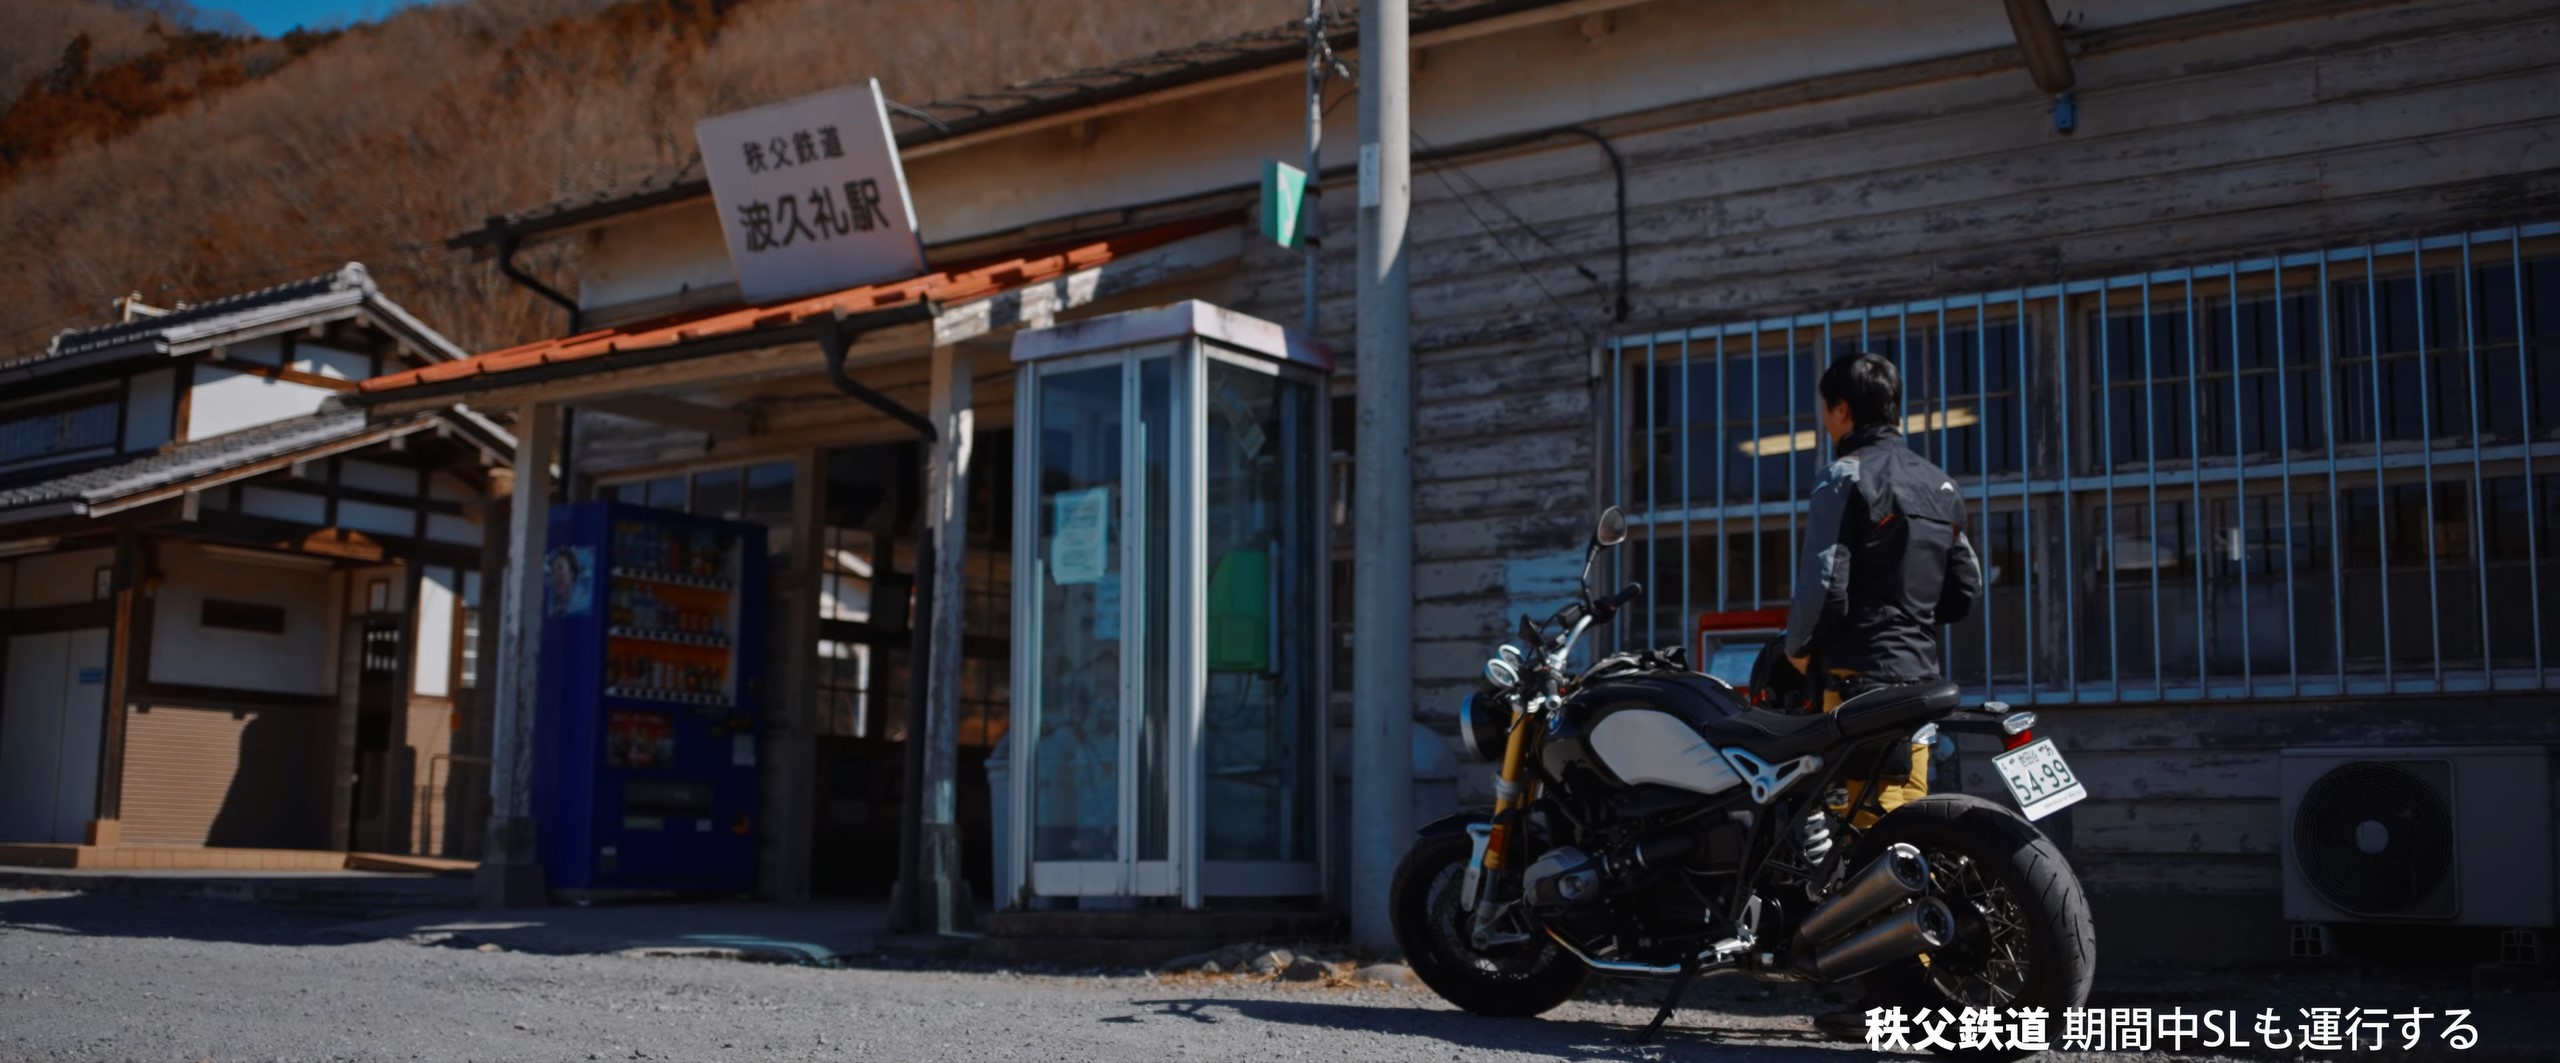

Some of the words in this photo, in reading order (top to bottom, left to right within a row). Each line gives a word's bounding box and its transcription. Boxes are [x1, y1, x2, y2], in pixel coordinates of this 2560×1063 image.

[742, 123, 845, 174] 秩父鉄道
[737, 177, 890, 253] 波久礼駅
